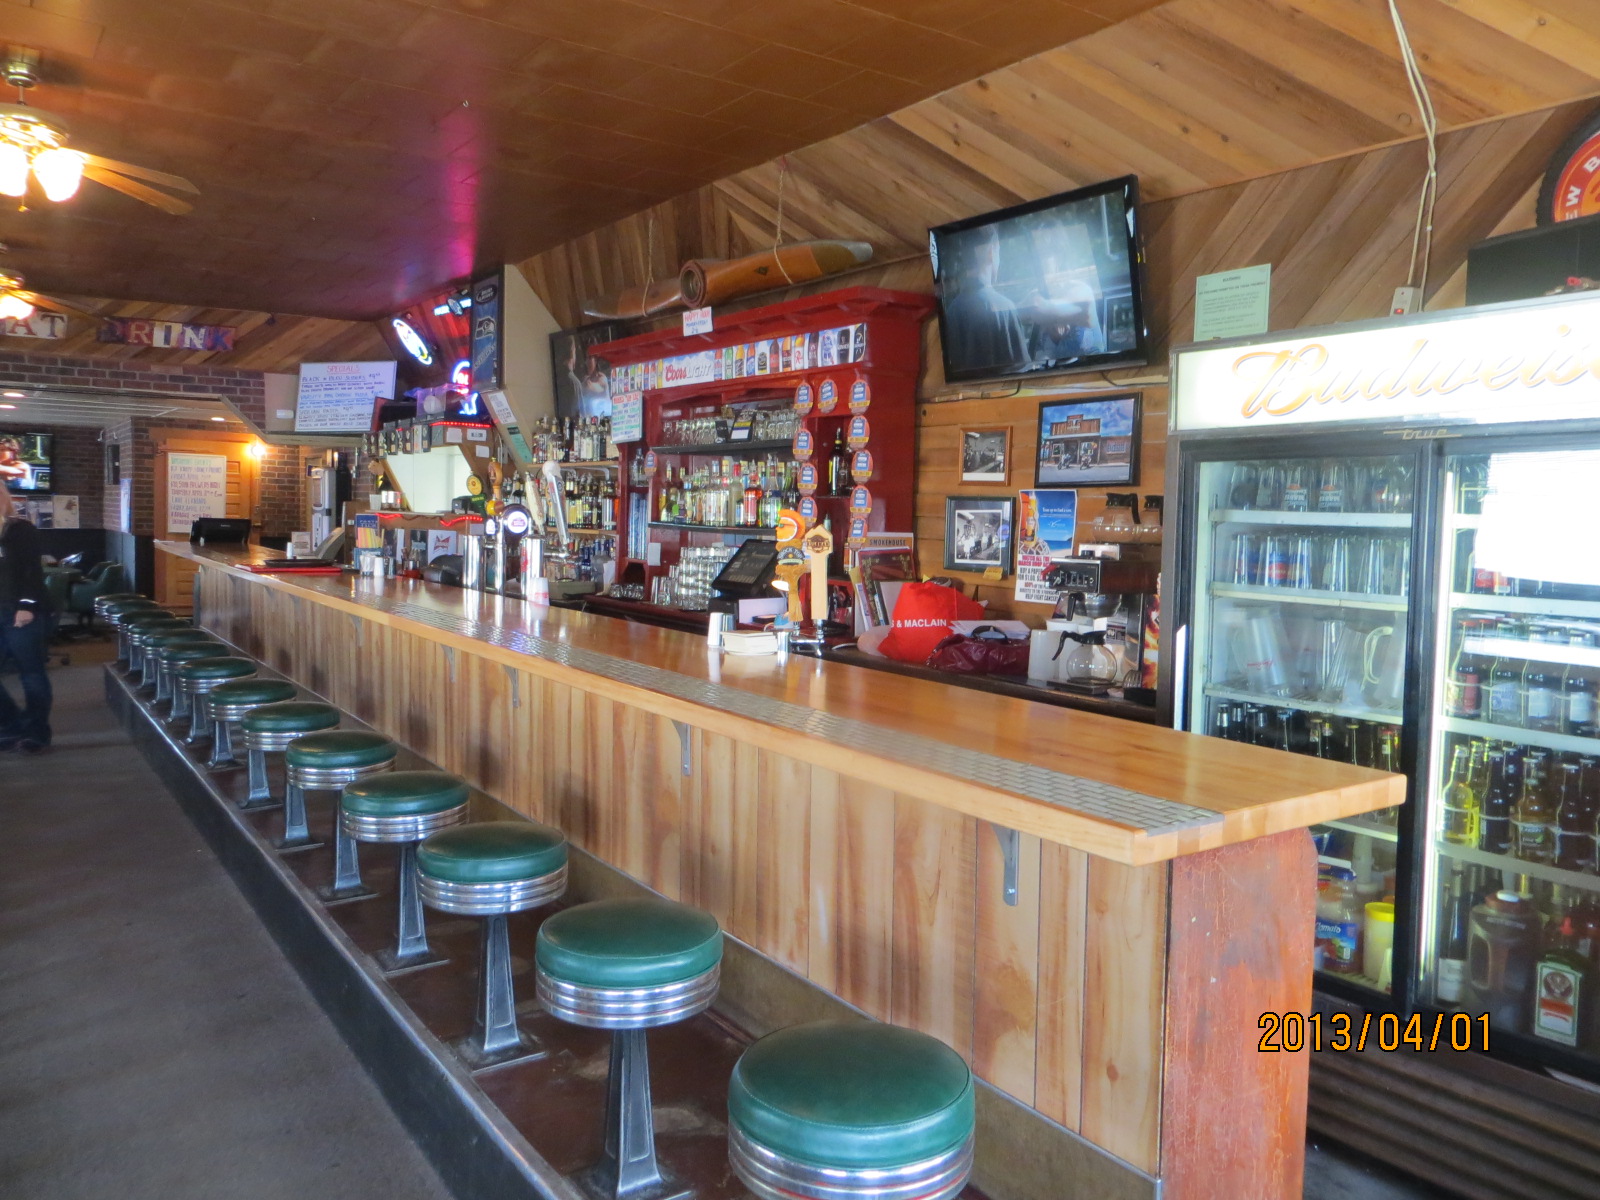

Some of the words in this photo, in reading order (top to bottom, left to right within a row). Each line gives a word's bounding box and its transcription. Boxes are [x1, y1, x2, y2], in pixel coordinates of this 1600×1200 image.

[99, 318, 237, 350] RINK
[665, 364, 687, 382] Coors
[687, 364, 712, 379] LIGHT
[1232, 325, 1600, 418] Budweis
[896, 620, 902, 628] &
[904, 618, 947, 628] MACLAIN
